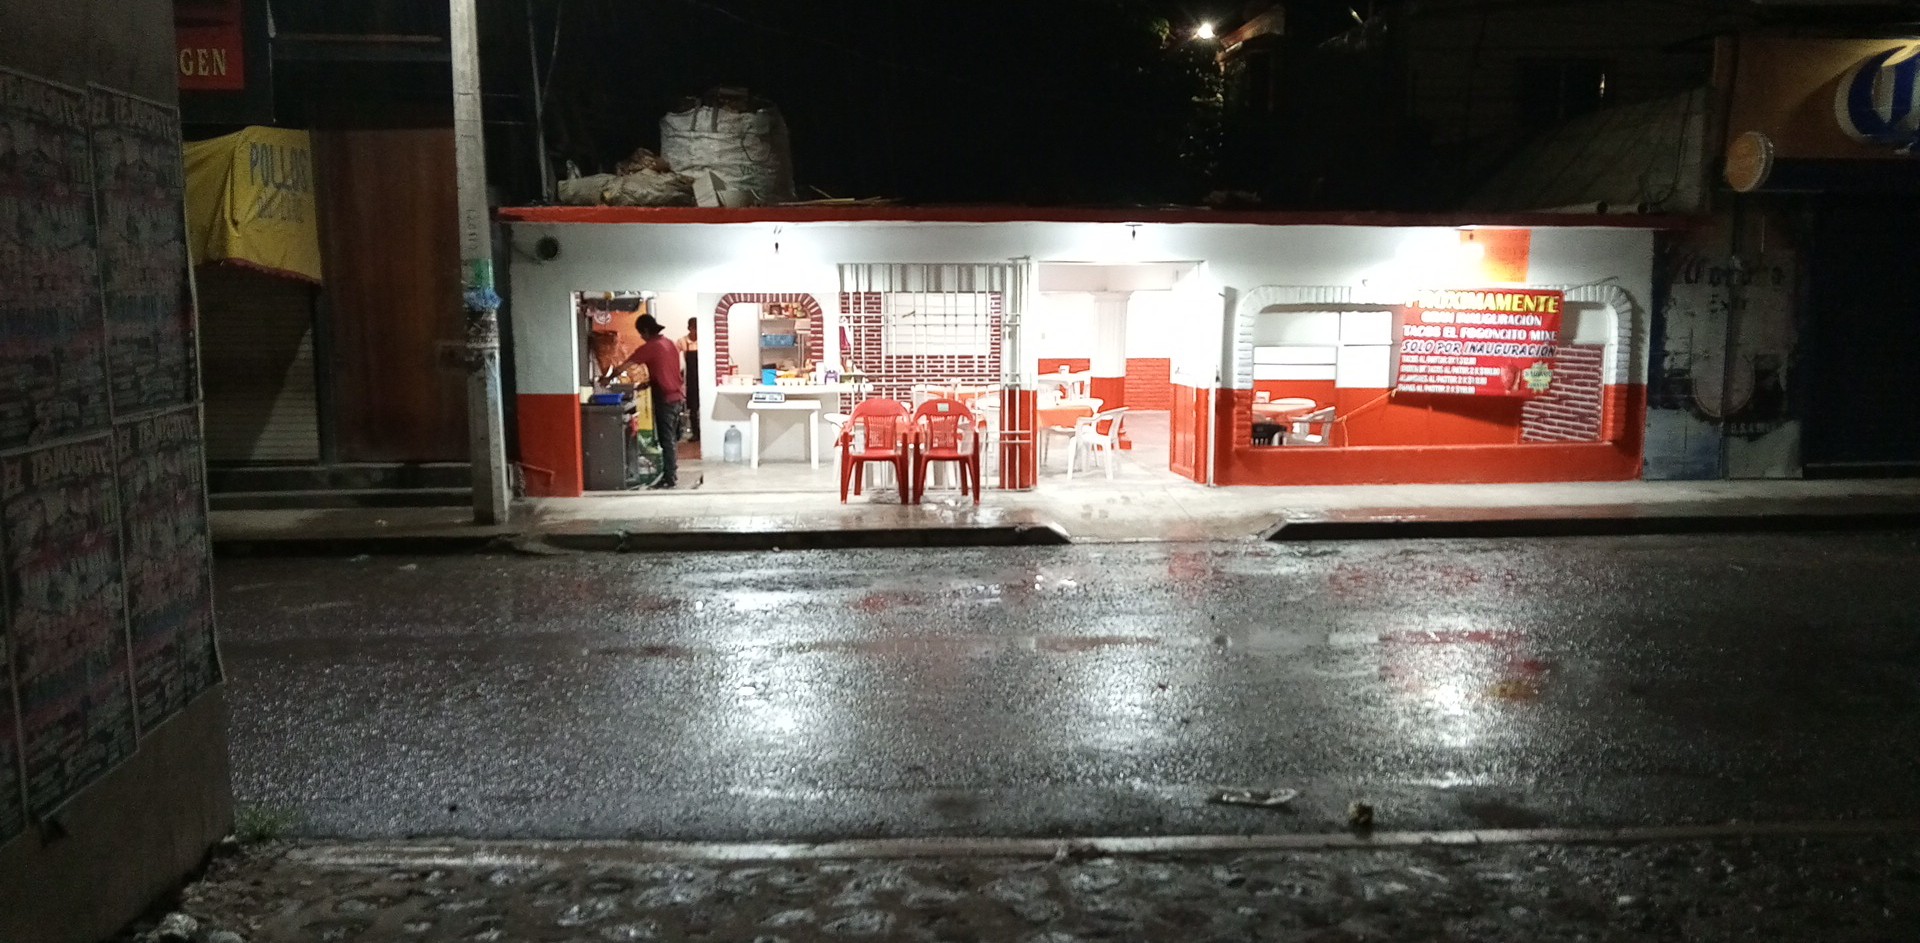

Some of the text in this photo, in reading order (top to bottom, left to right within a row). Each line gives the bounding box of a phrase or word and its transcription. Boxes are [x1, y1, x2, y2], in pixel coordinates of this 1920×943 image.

[180, 47, 226, 76] GEN
[1443, 326, 1458, 338] EL
[1460, 327, 1527, 340] FOGONCITO
[1402, 339, 1557, 357] SOLO POR INAUGURACIÓN
